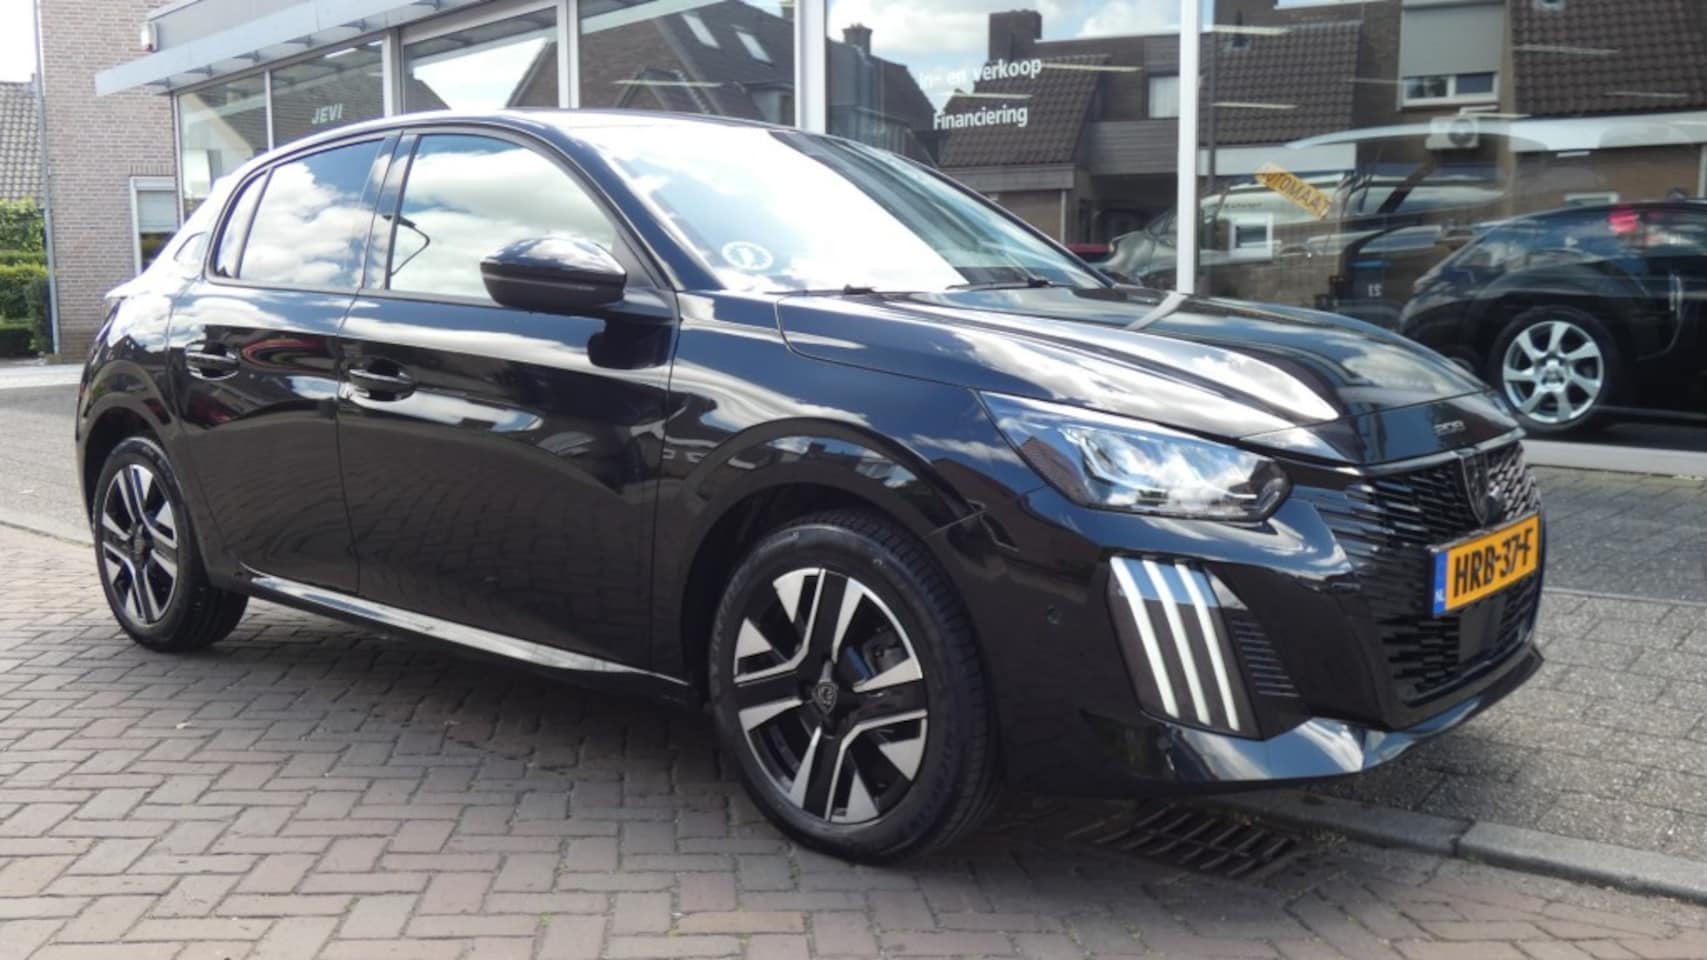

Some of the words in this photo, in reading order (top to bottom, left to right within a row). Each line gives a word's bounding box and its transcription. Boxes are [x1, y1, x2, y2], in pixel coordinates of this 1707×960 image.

[972, 58, 1041, 81] verkoop
[311, 103, 343, 124] JEVI
[932, 104, 1028, 130] Financiering
[1259, 167, 1330, 216] UTOMAAT
[1454, 527, 1533, 597] HRB-37-F
